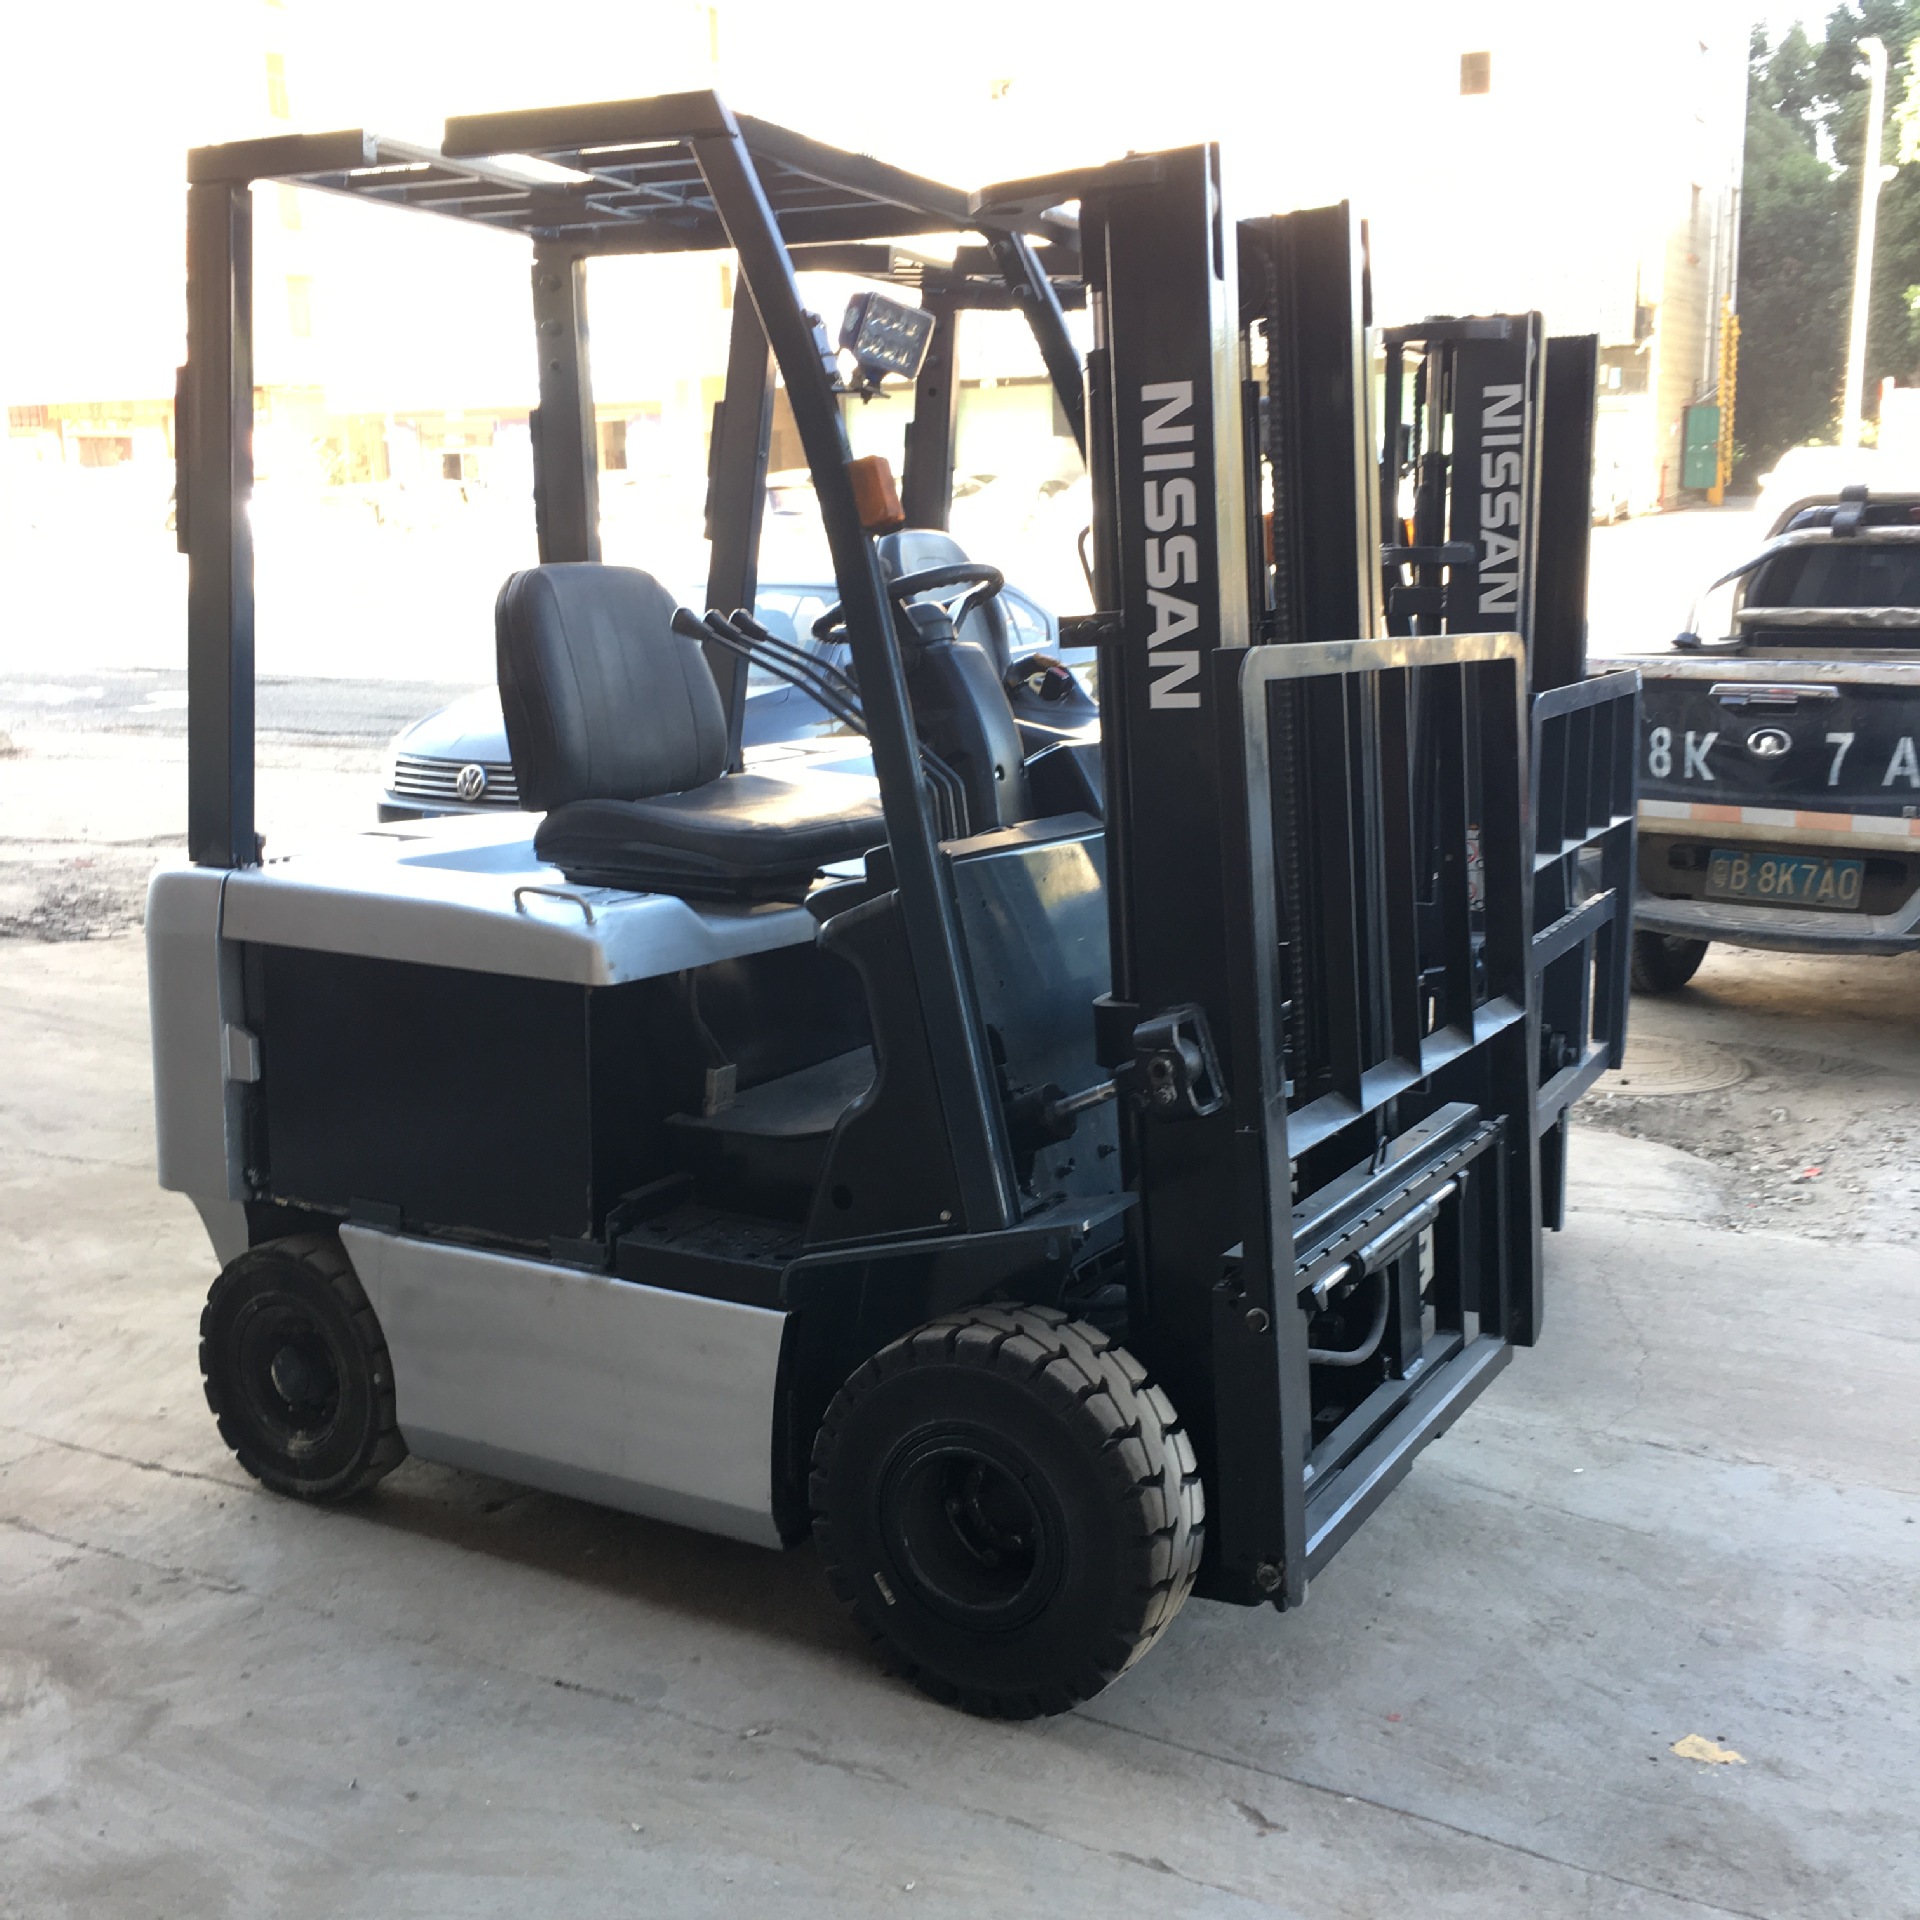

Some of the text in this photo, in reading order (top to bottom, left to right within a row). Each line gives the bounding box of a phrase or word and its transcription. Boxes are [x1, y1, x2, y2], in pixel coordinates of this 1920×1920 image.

[1140, 380, 1201, 710] NISSAN
[1478, 383, 1524, 614] NISSAN
[1825, 732, 1855, 786] 7
